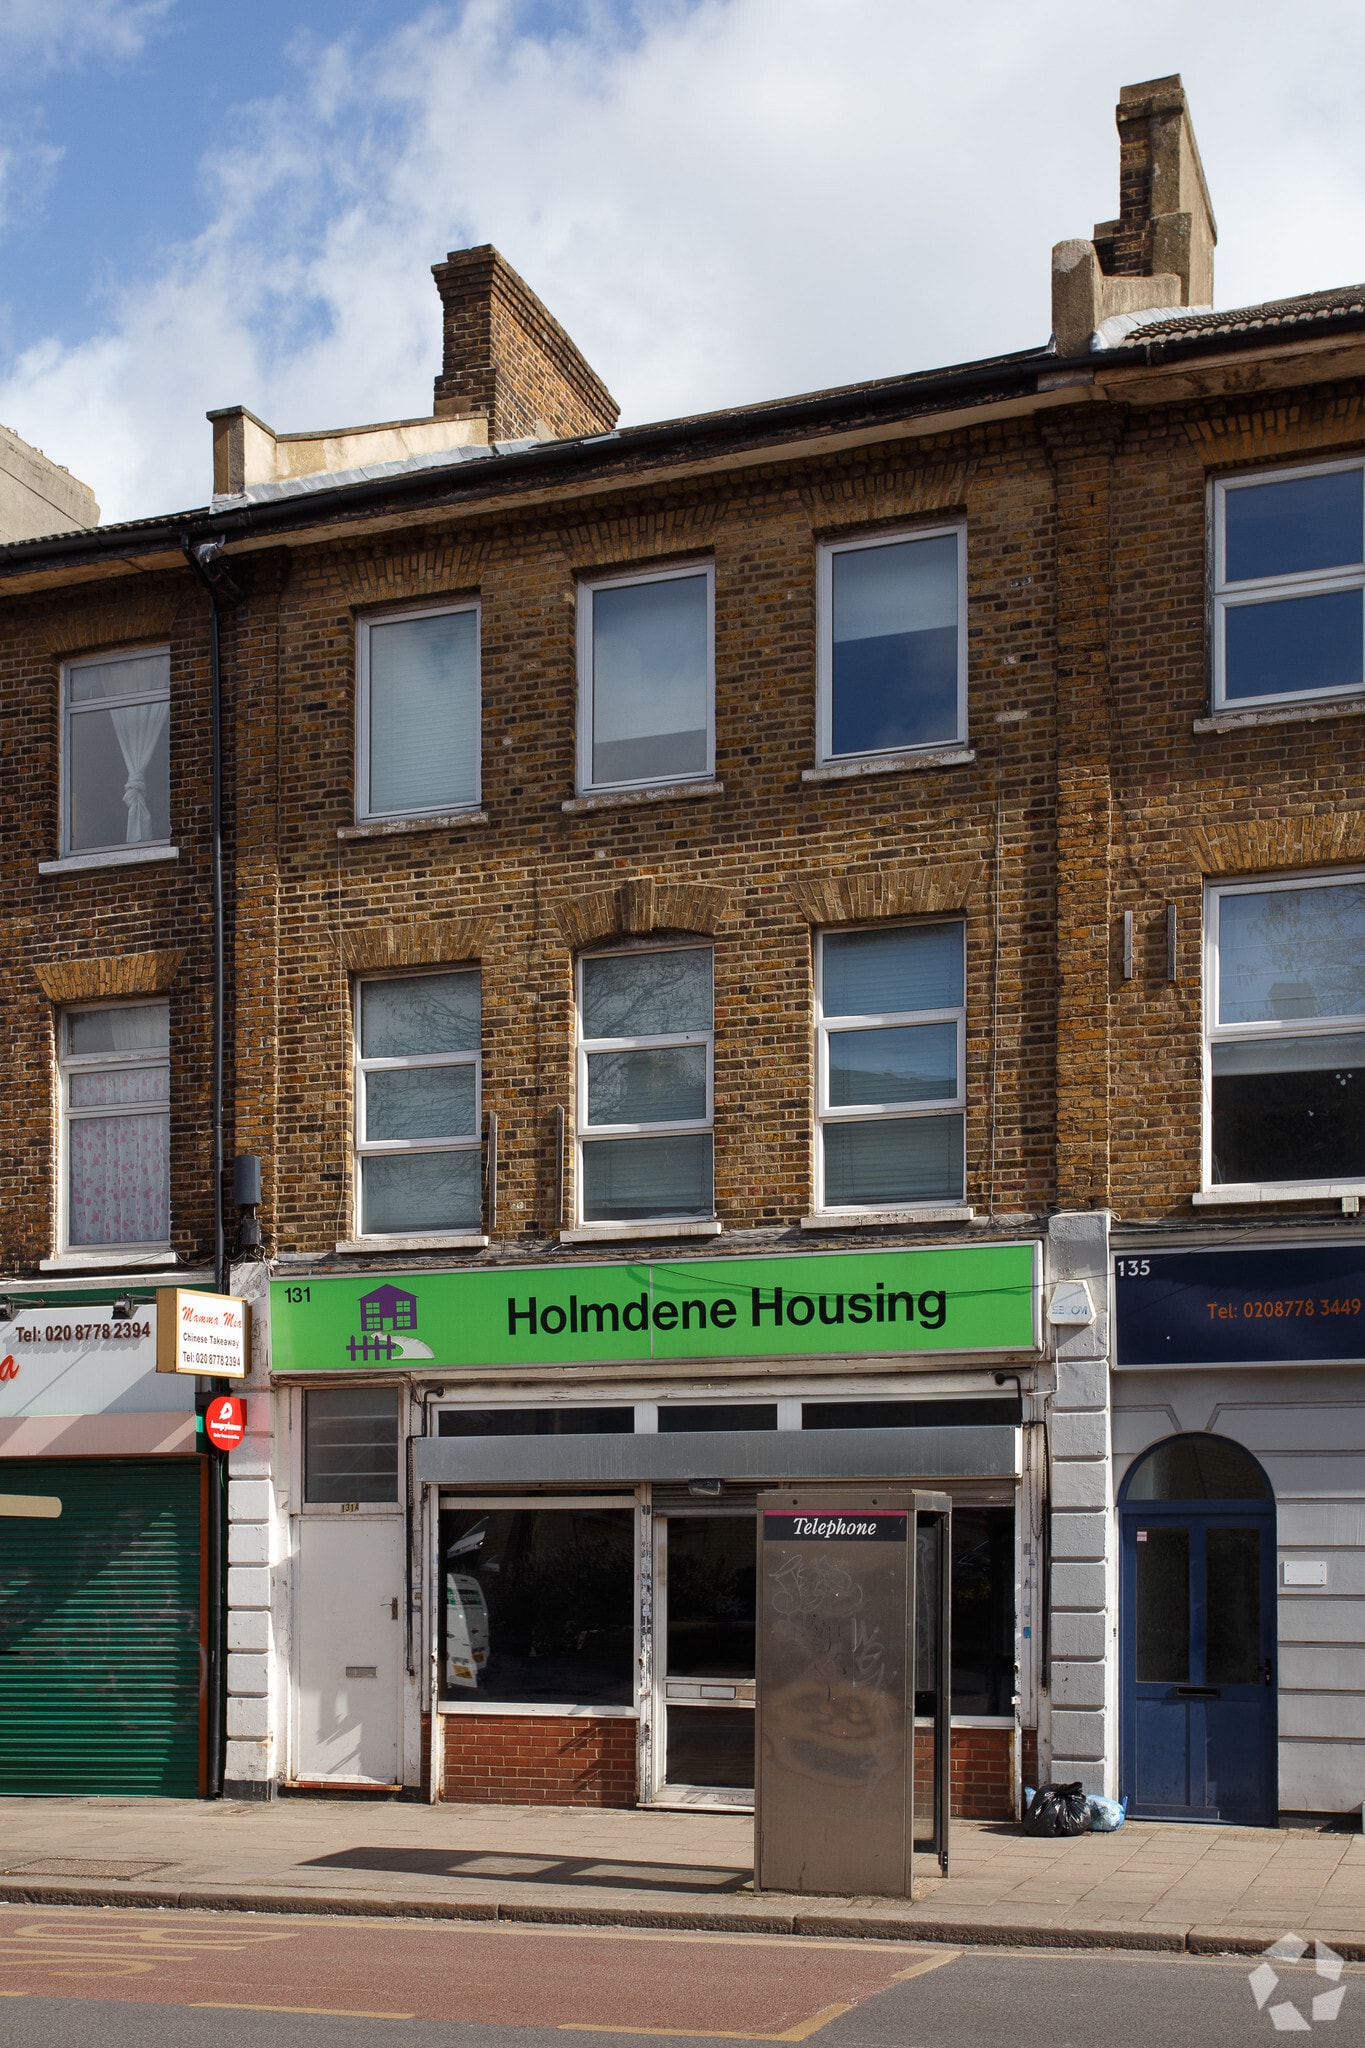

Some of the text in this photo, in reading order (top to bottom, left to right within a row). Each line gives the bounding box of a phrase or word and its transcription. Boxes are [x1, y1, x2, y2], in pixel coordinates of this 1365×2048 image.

[1117, 1259, 1151, 1277] 135
[284, 1286, 311, 1304] 131
[181, 1306, 243, 1328] Mamma Mia
[507, 1281, 948, 1336] Holmdene Housing
[1207, 1297, 1362, 1320] Tel: 0208778 3449
[16, 1321, 151, 1343] Tel: 020 8778 2394
[182, 1332, 240, 1349] Chinese Takeaway
[182, 1351, 241, 1367] Tel: 020 8778 2394
[340, 1502, 360, 1513] 131A
[793, 1516, 878, 1539] Telephone
